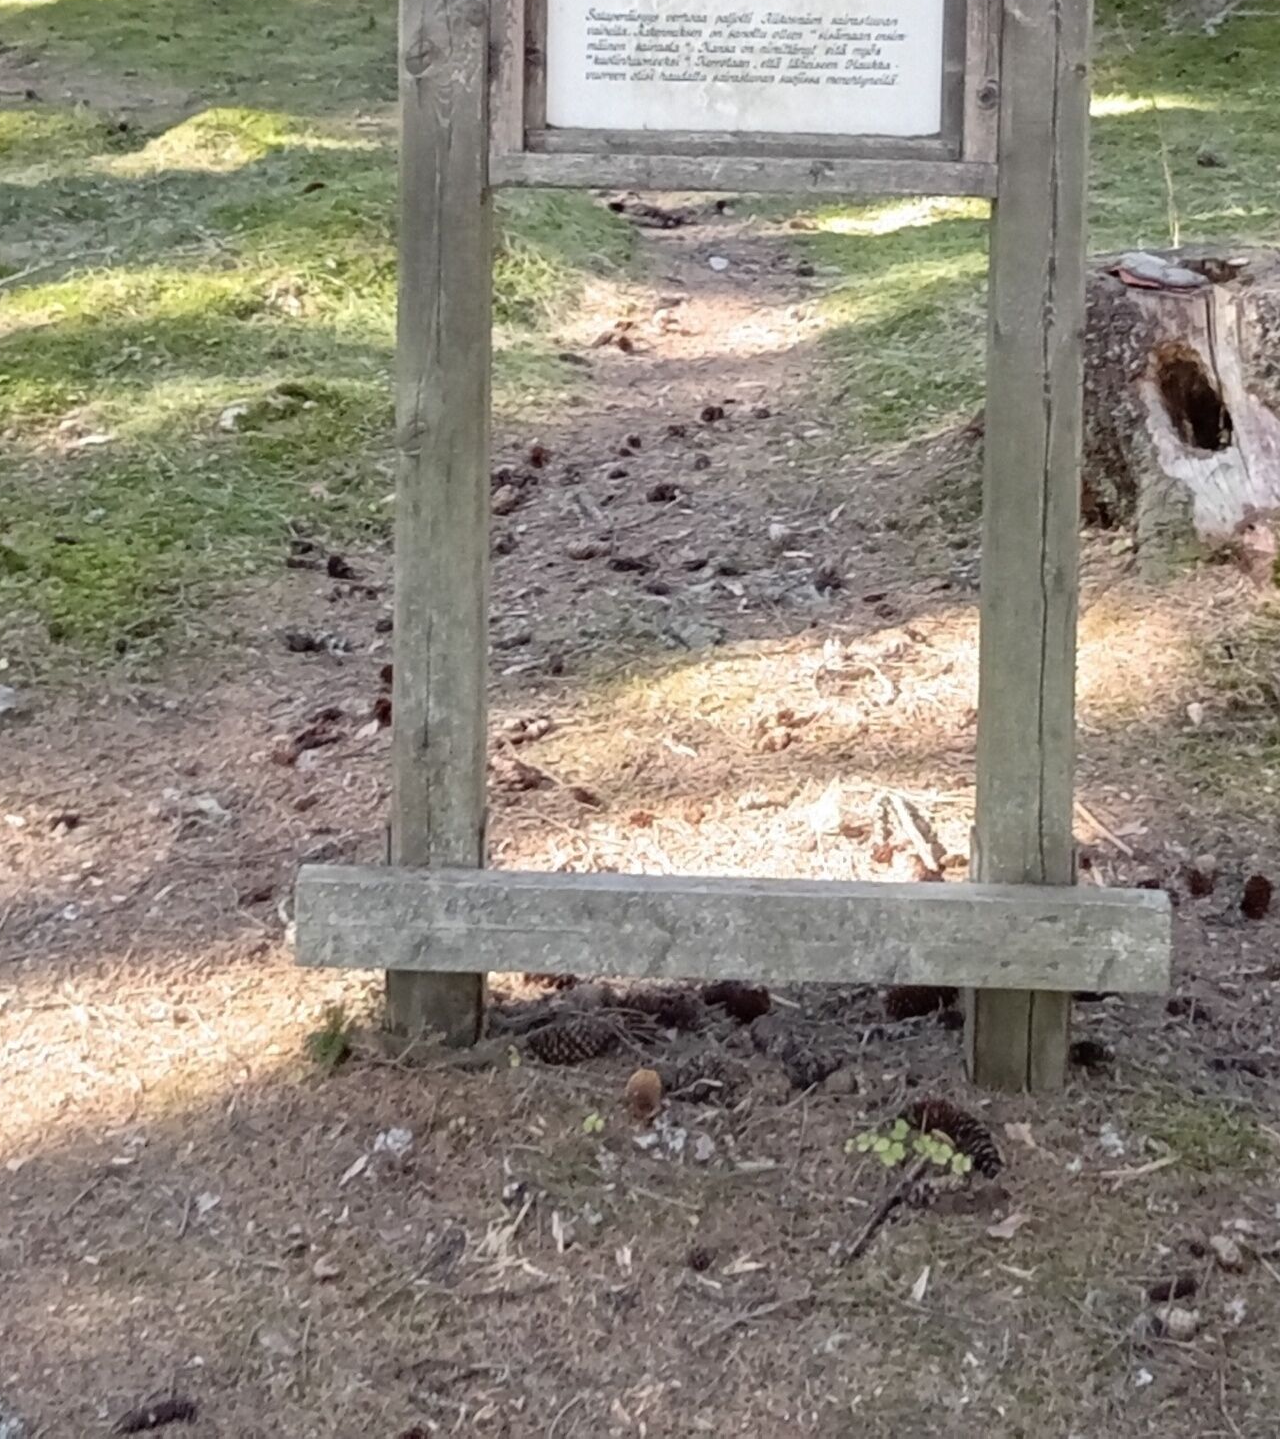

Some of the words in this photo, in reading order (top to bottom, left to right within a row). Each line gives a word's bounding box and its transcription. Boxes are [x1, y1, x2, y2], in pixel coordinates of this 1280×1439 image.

[709, 31, 723, 39] on
[740, 46, 755, 54] on
[852, 44, 882, 59] myös
